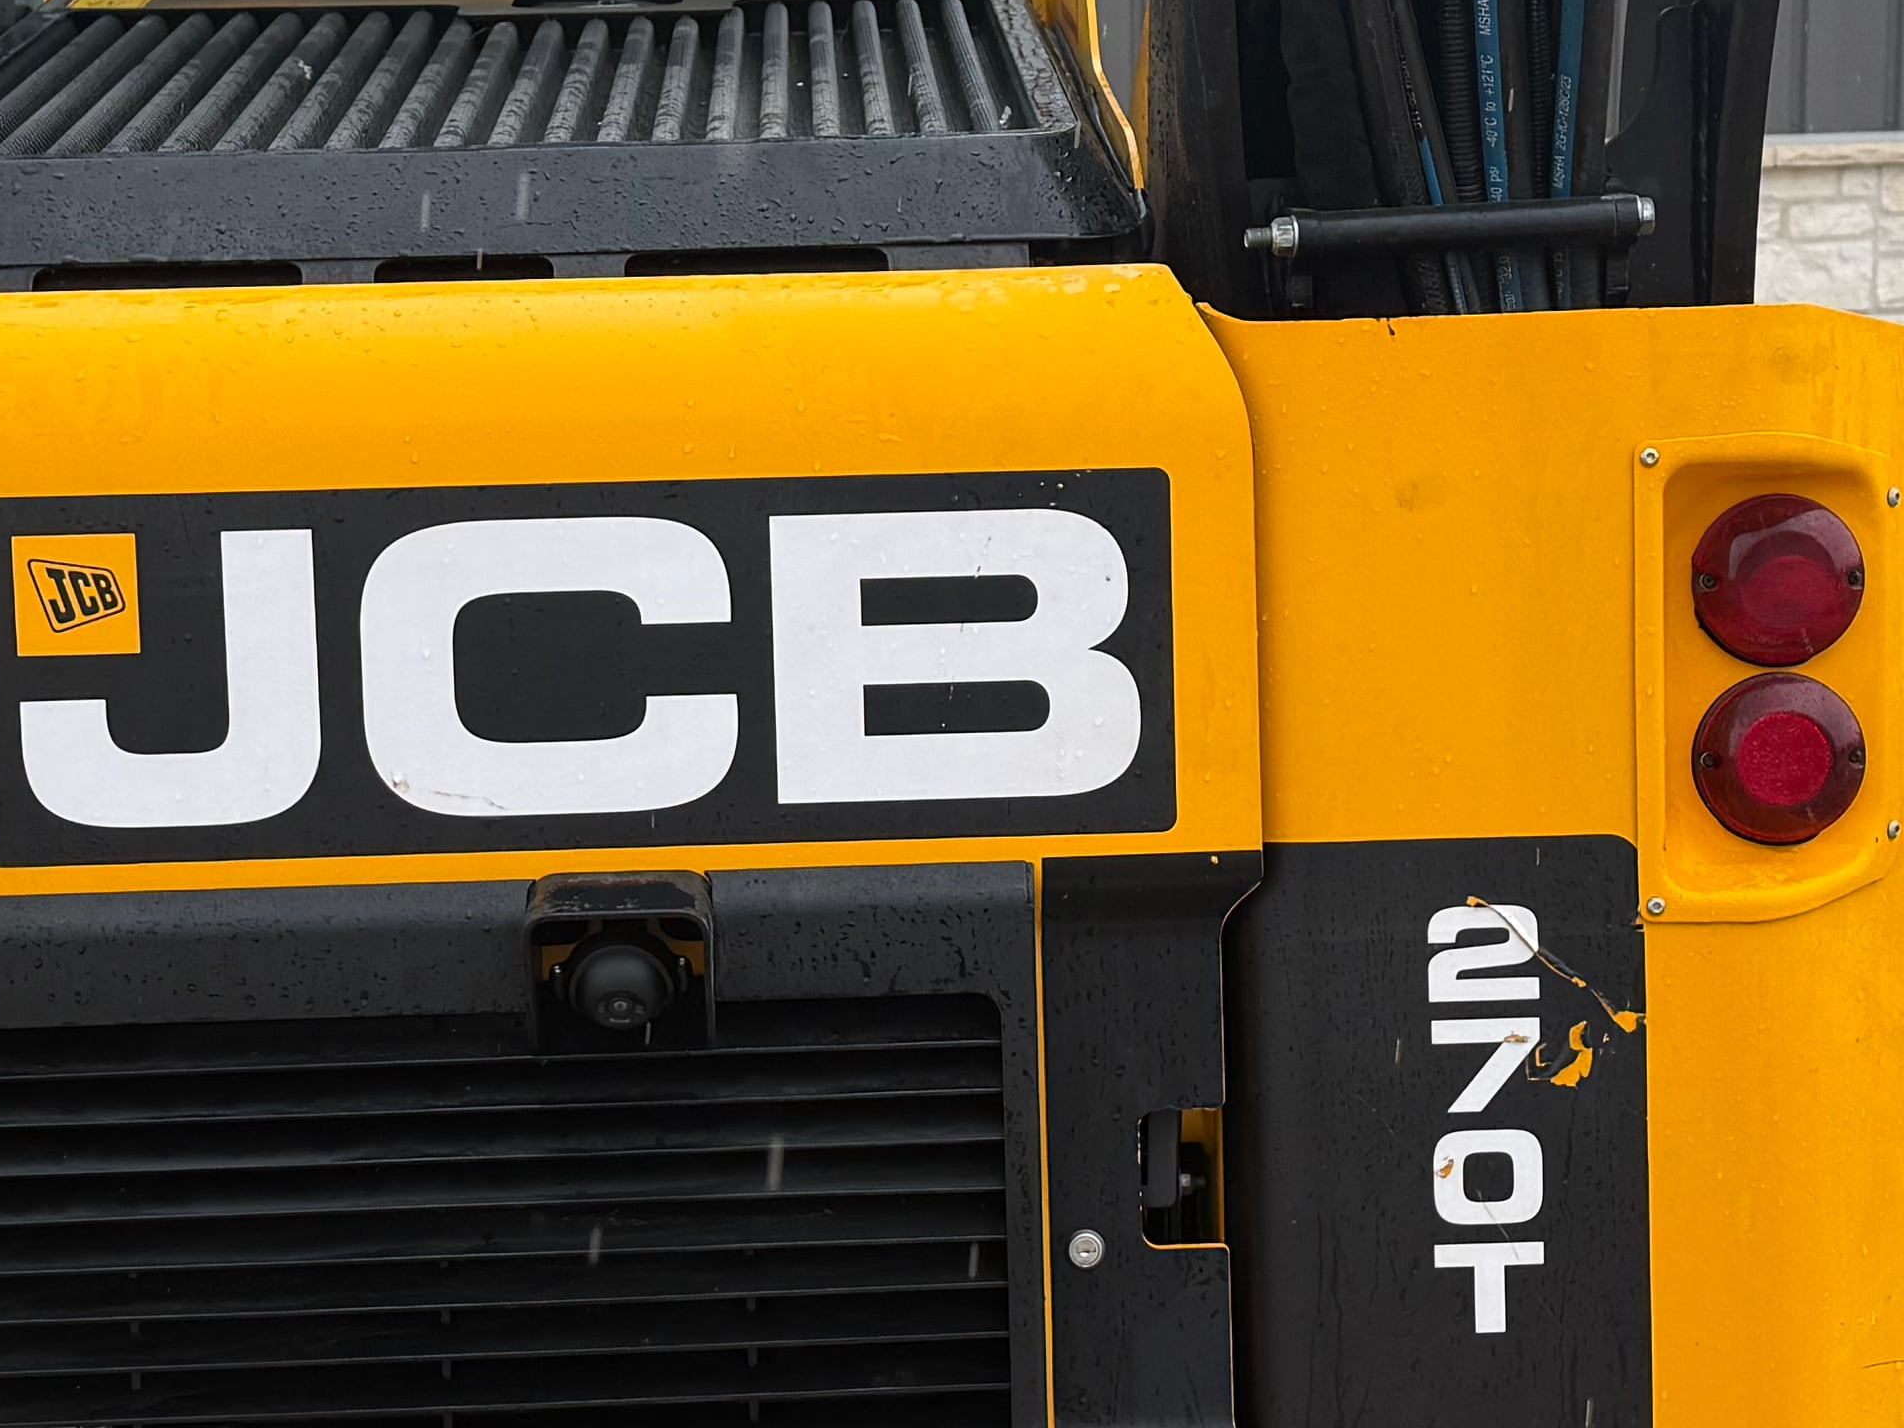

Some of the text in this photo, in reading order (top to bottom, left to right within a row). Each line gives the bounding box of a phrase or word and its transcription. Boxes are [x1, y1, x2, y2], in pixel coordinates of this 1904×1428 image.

[20, 507, 1142, 829] JCB
[45, 566, 118, 624] JCB
[1427, 903, 1545, 1333] 270T
